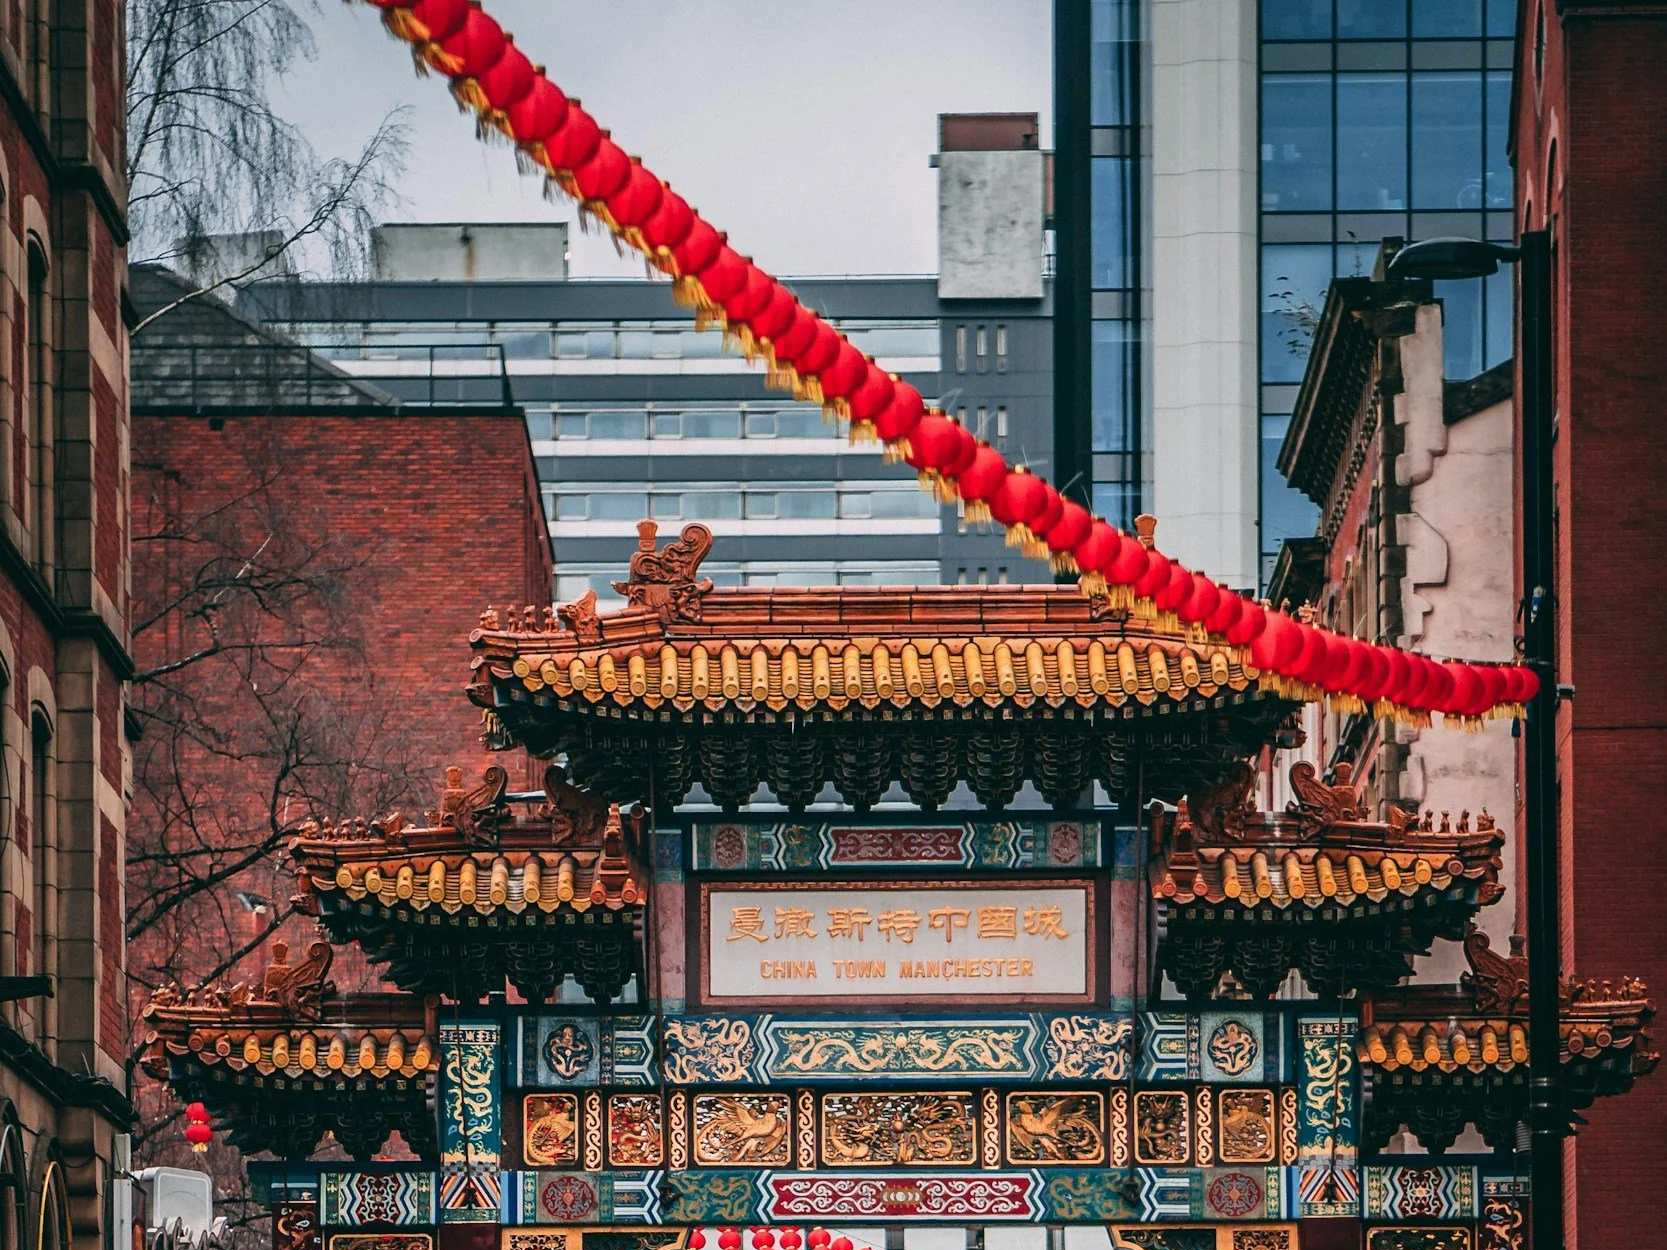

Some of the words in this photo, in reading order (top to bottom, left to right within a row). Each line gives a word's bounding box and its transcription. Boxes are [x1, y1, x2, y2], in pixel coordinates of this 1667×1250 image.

[760, 958, 818, 979] CHINA
[832, 958, 886, 979] TOWN
[898, 957, 1035, 979] MANCHESTER
